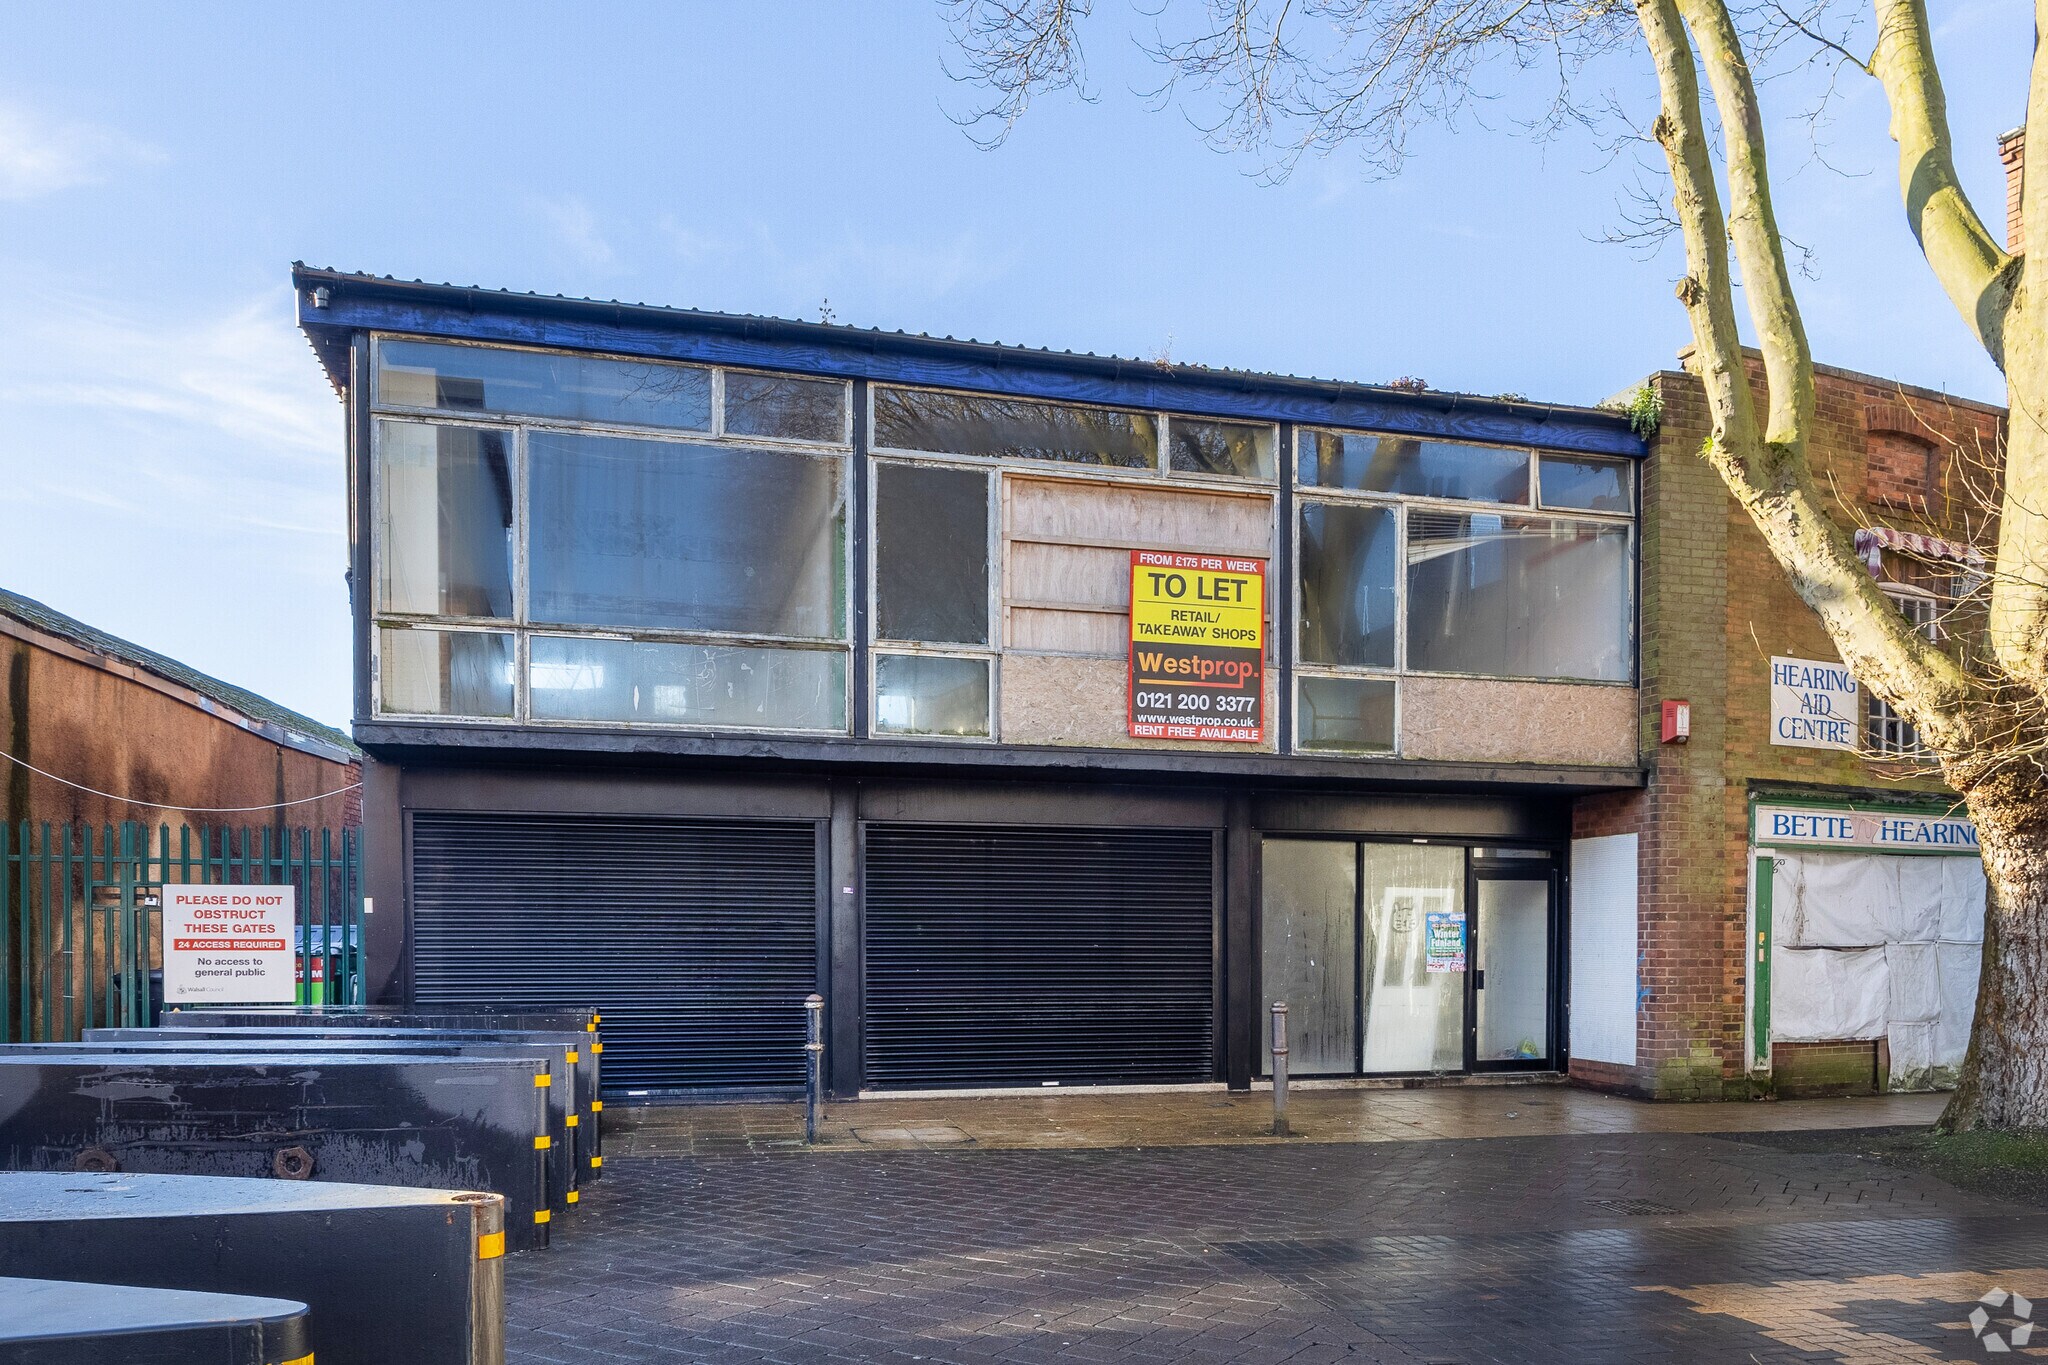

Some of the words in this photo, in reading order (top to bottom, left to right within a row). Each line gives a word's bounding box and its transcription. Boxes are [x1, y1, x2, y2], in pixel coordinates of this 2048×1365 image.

[1140, 553, 1172, 566] FROM
[1175, 557, 1198, 567] £175
[1201, 559, 1222, 569] PER
[1226, 560, 1258, 573] WEEK
[1148, 572, 1187, 598] TO
[1197, 576, 1248, 603] LET
[1171, 609, 1221, 624] RETAIL/
[1137, 623, 1207, 638] TAKEAWAY
[1212, 627, 1256, 641] SHOPS
[1773, 663, 1856, 694] HEARING
[1136, 691, 1172, 708] 0121
[1177, 693, 1210, 711] 200
[1216, 695, 1256, 713] 3377
[1800, 692, 1831, 716] AID
[1137, 714, 1255, 728] www.westprop.co.uk
[1134, 725, 1165, 736] RENT
[1168, 726, 1196, 737] FREE
[1200, 728, 1259, 740] AVAILABLE
[1778, 716, 1850, 744] CENTRE
[176, 895, 228, 905] PLEASE
[232, 896, 252, 905] DO
[255, 896, 283, 905] NOT
[193, 910, 266, 919] OBSTRUCT
[184, 924, 228, 933] THESE
[232, 924, 276, 933] GATES
[197, 958, 212, 966] No
[253, 958, 263, 966] to
[194, 968, 233, 978] general
[235, 968, 266, 978] public
